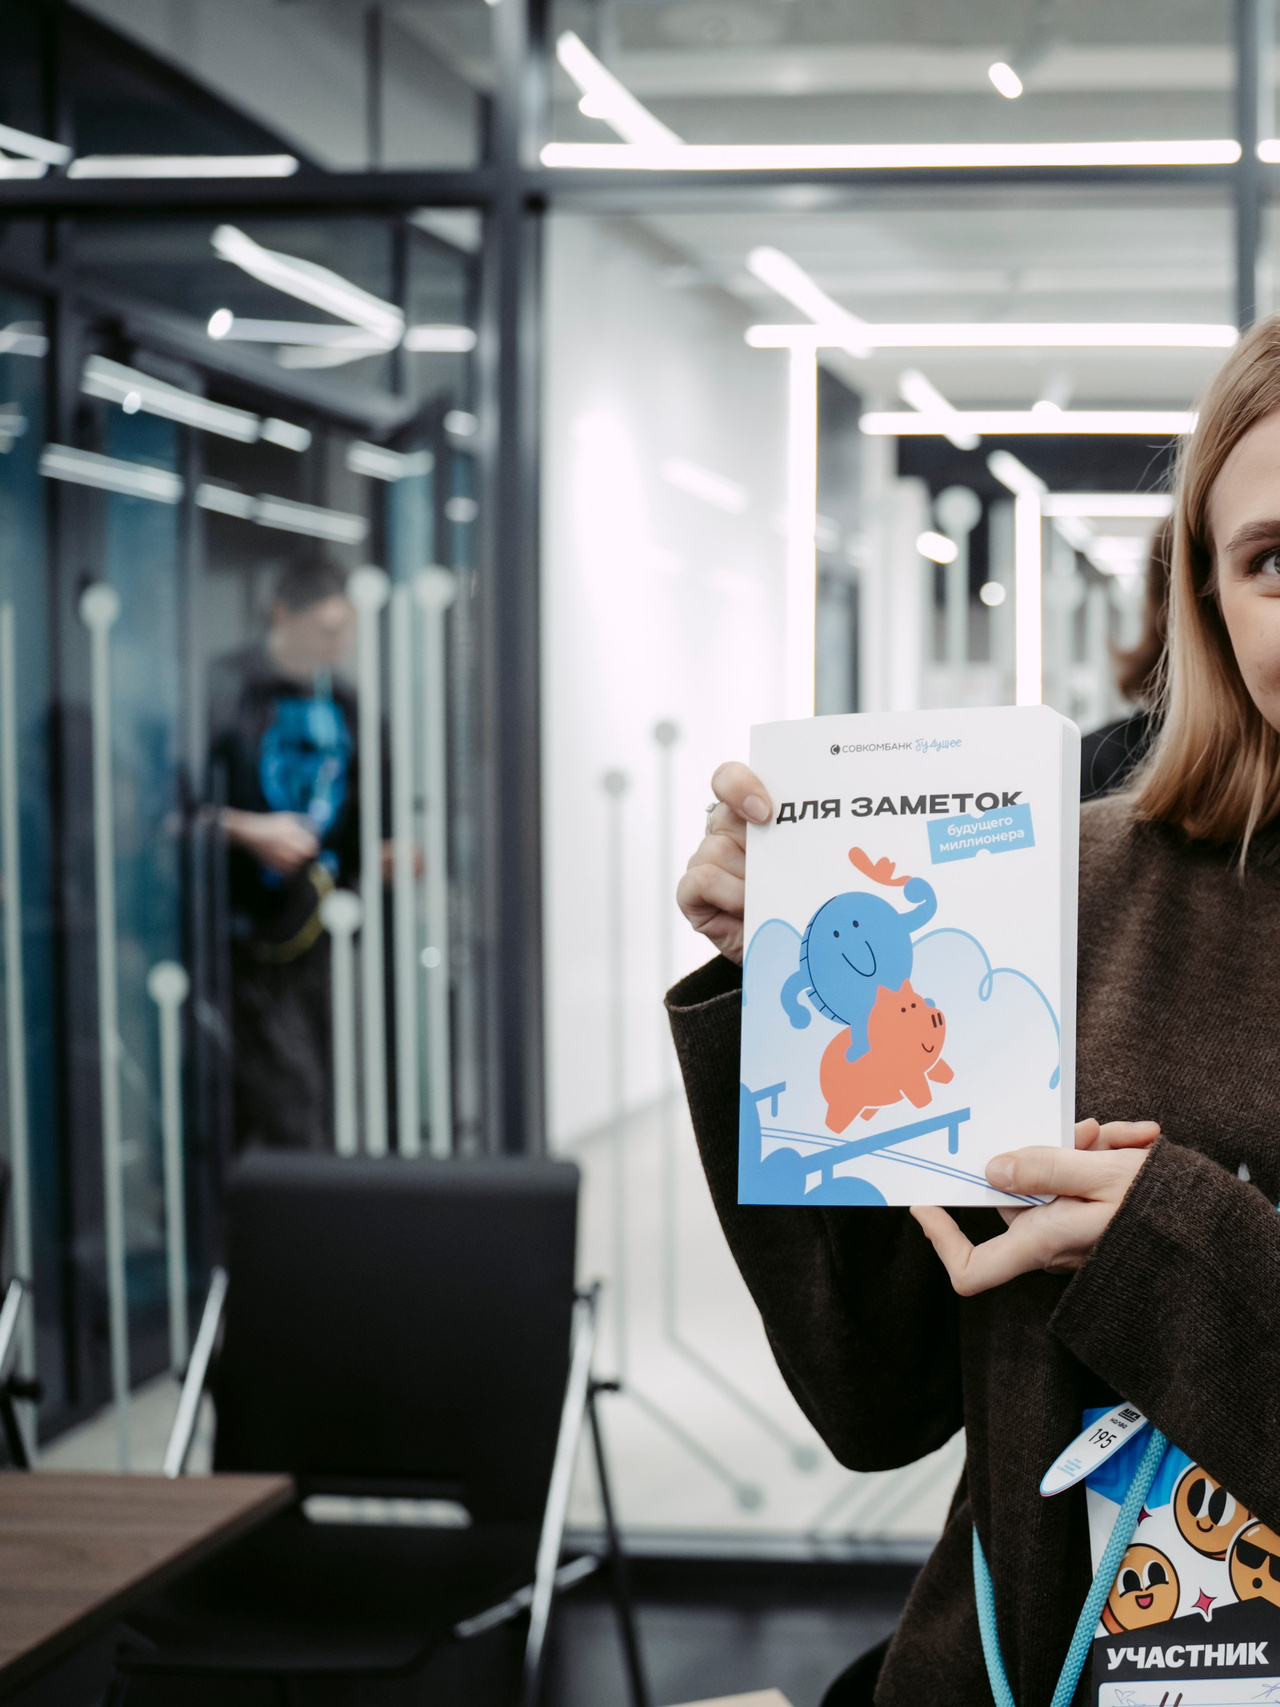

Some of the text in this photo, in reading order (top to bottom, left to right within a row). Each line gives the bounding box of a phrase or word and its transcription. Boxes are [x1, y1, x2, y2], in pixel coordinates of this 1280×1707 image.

[842, 742, 913, 753] СОВКОМБАНК
[776, 791, 1022, 825] ДЛЯ ЗАМЕТОК
[947, 816, 1013, 837] будущего
[939, 828, 1025, 853] миллионера
[1088, 1428, 1118, 1449] 195
[1106, 1641, 1269, 1670] УЧАСТНИК
